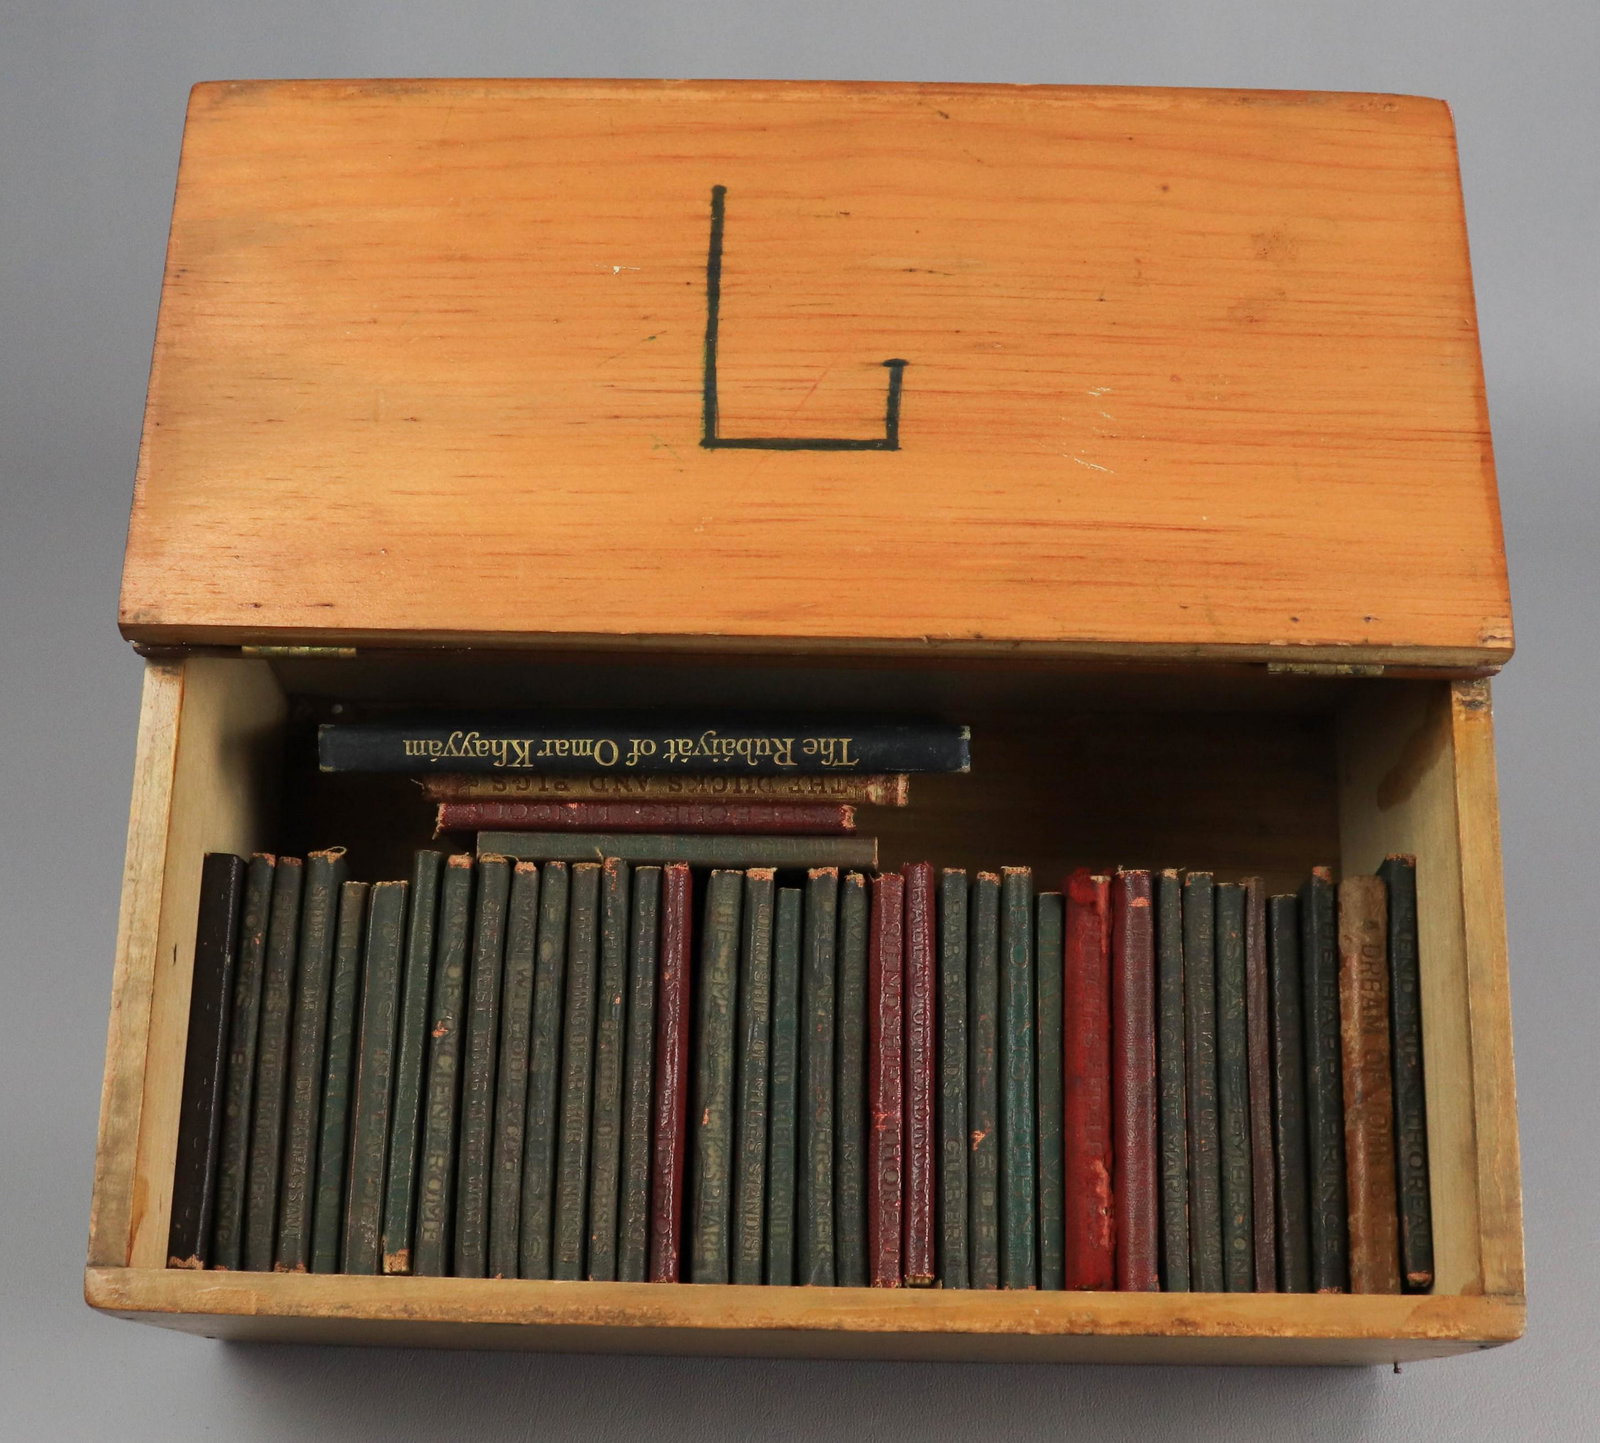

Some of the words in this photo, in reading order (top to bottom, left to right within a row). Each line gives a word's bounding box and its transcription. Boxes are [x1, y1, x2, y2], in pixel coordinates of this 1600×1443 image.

[403, 731, 535, 767] Khayyám
[536, 738, 620, 766] Omar
[626, 738, 656, 767] of
[664, 730, 796, 767] Rubáiyát
[803, 738, 858, 767] The
[588, 774, 650, 795] AND
[1319, 903, 1337, 964] THE
[1360, 944, 1384, 1035] DREAM
[1320, 979, 1338, 1103] HAPPY
[424, 1152, 445, 1242] ROME
[1321, 1116, 1340, 1256] PRINCE
[1407, 1108, 1428, 1250] THOREAU
